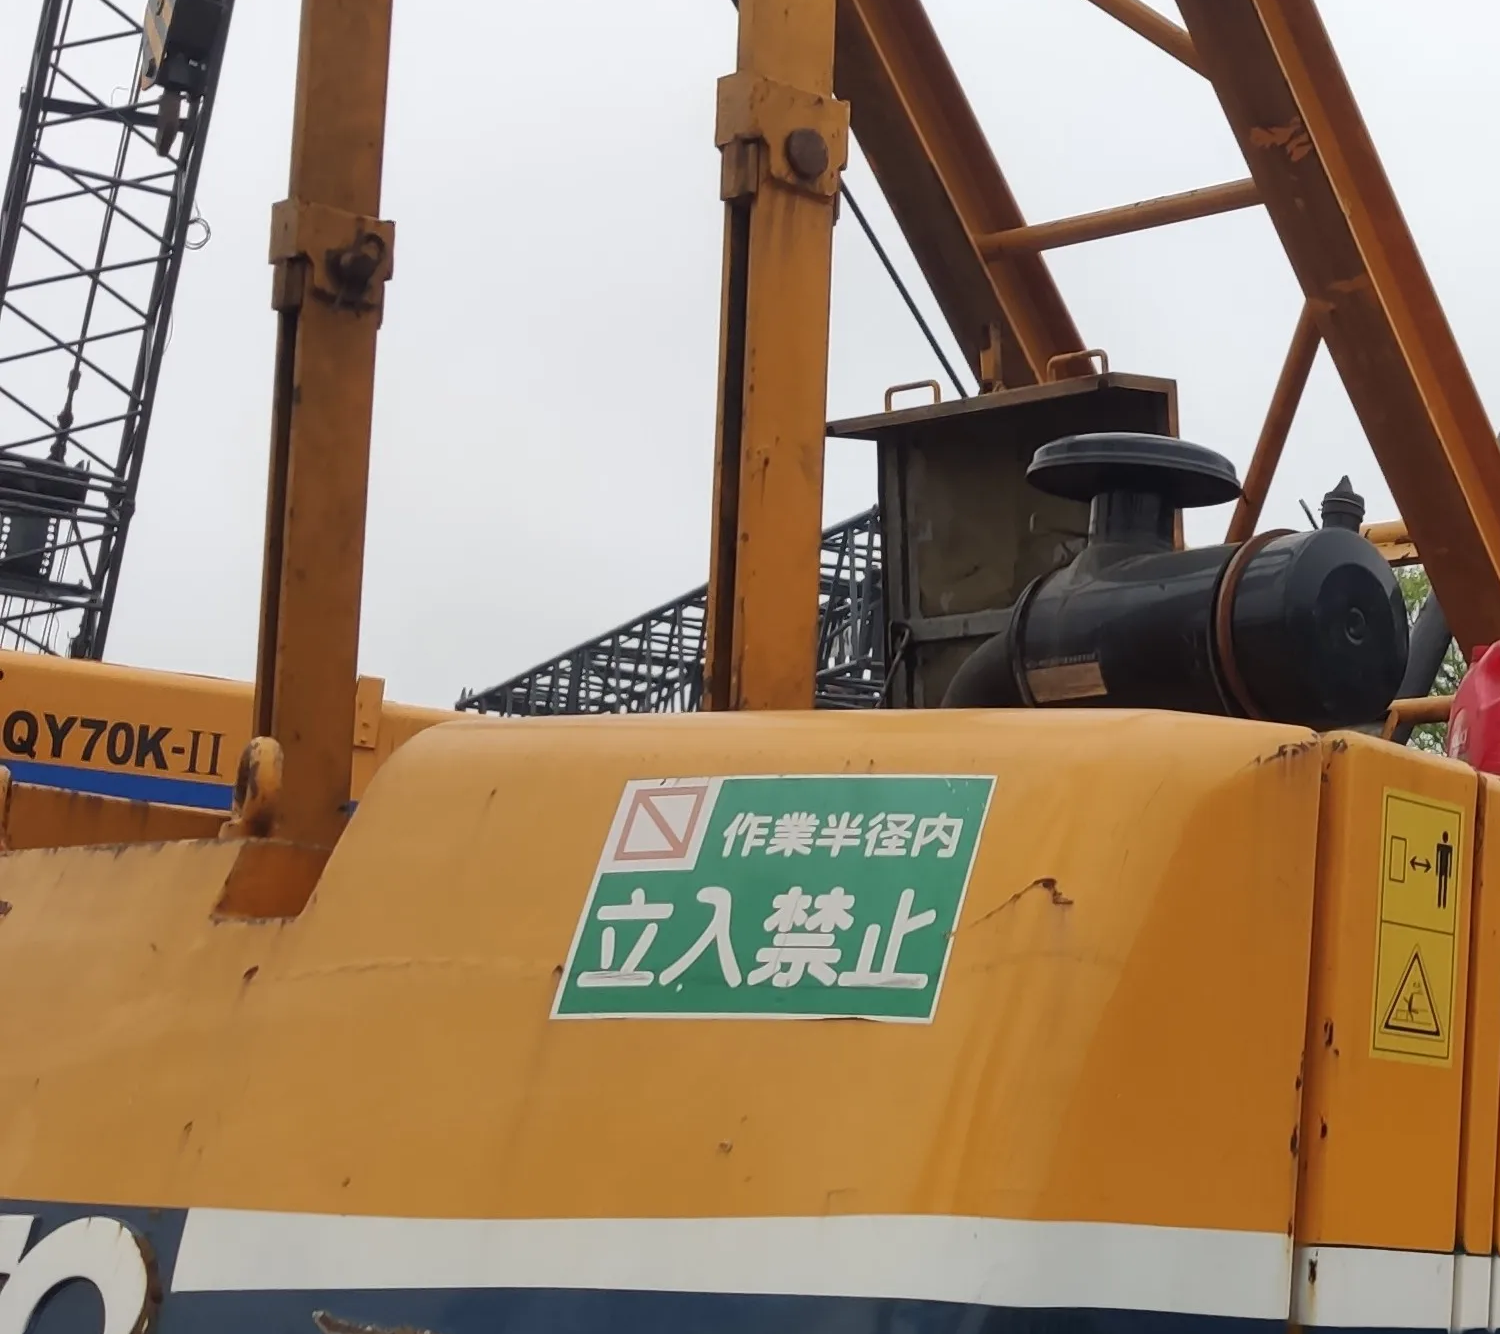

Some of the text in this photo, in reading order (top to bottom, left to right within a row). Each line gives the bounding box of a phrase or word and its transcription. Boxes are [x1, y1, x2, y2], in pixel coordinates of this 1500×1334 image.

[721, 811, 965, 859] 作業半径内
[576, 885, 937, 990] 立入禁止
